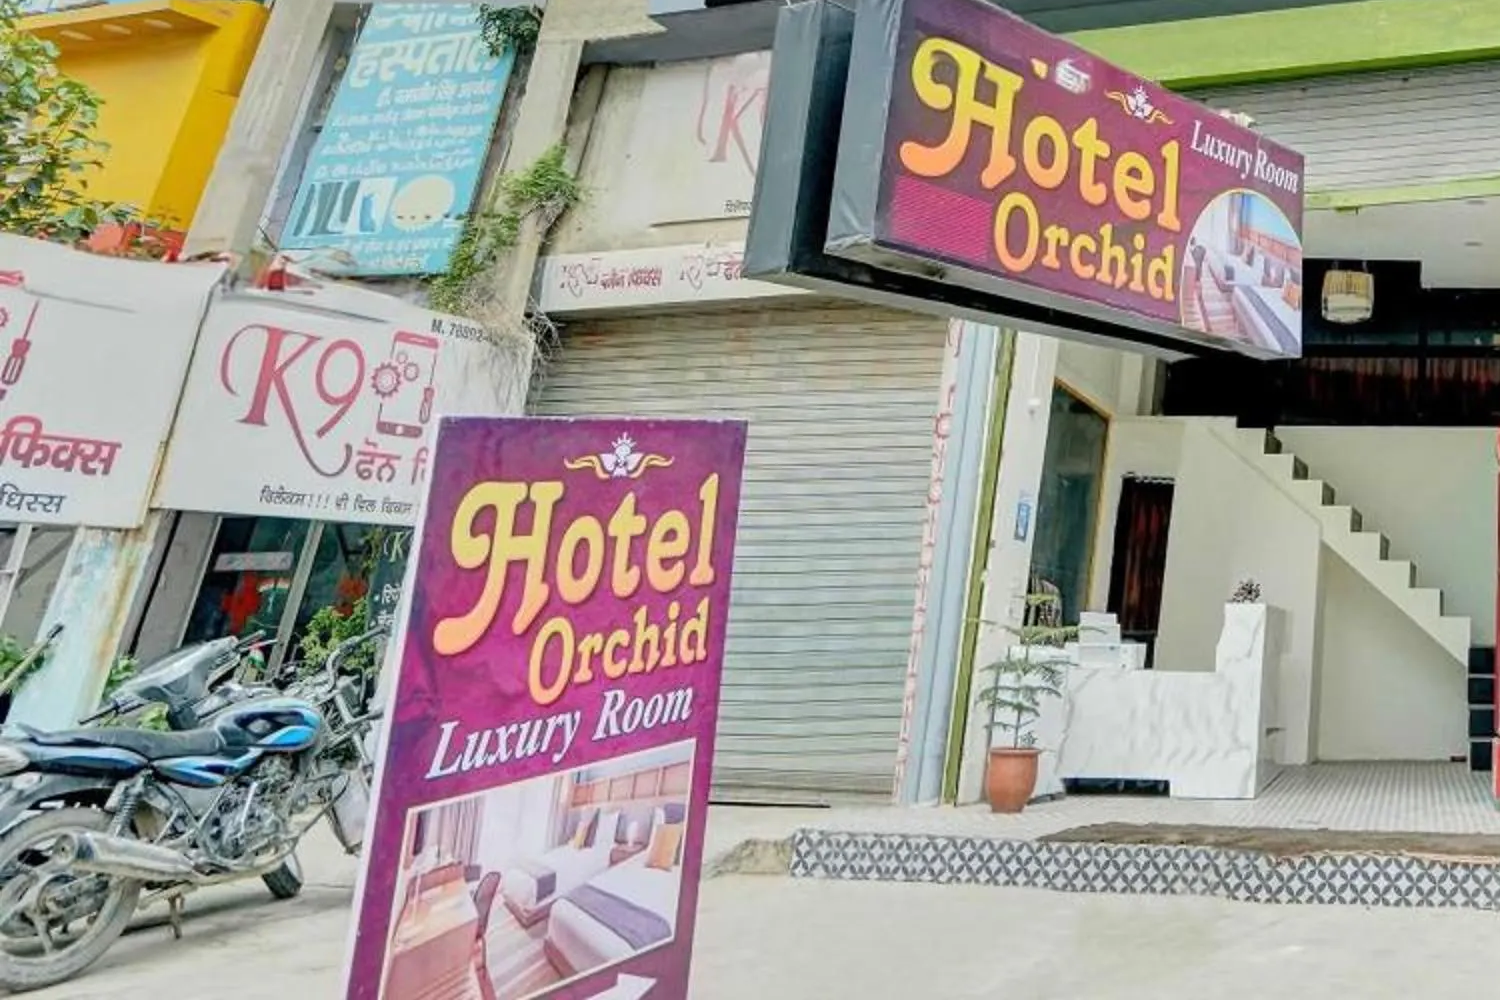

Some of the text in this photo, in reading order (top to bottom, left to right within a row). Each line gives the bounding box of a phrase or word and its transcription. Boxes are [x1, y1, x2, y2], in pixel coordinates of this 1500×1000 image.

[900, 36, 1182, 233] Hotel
[1190, 119, 1300, 194] Luxury Room
[994, 190, 1177, 302] Orchid
[220, 323, 366, 478] K9
[432, 473, 719, 656] Hotel
[527, 599, 711, 705] Orchid
[425, 685, 694, 779] Luxury Room
